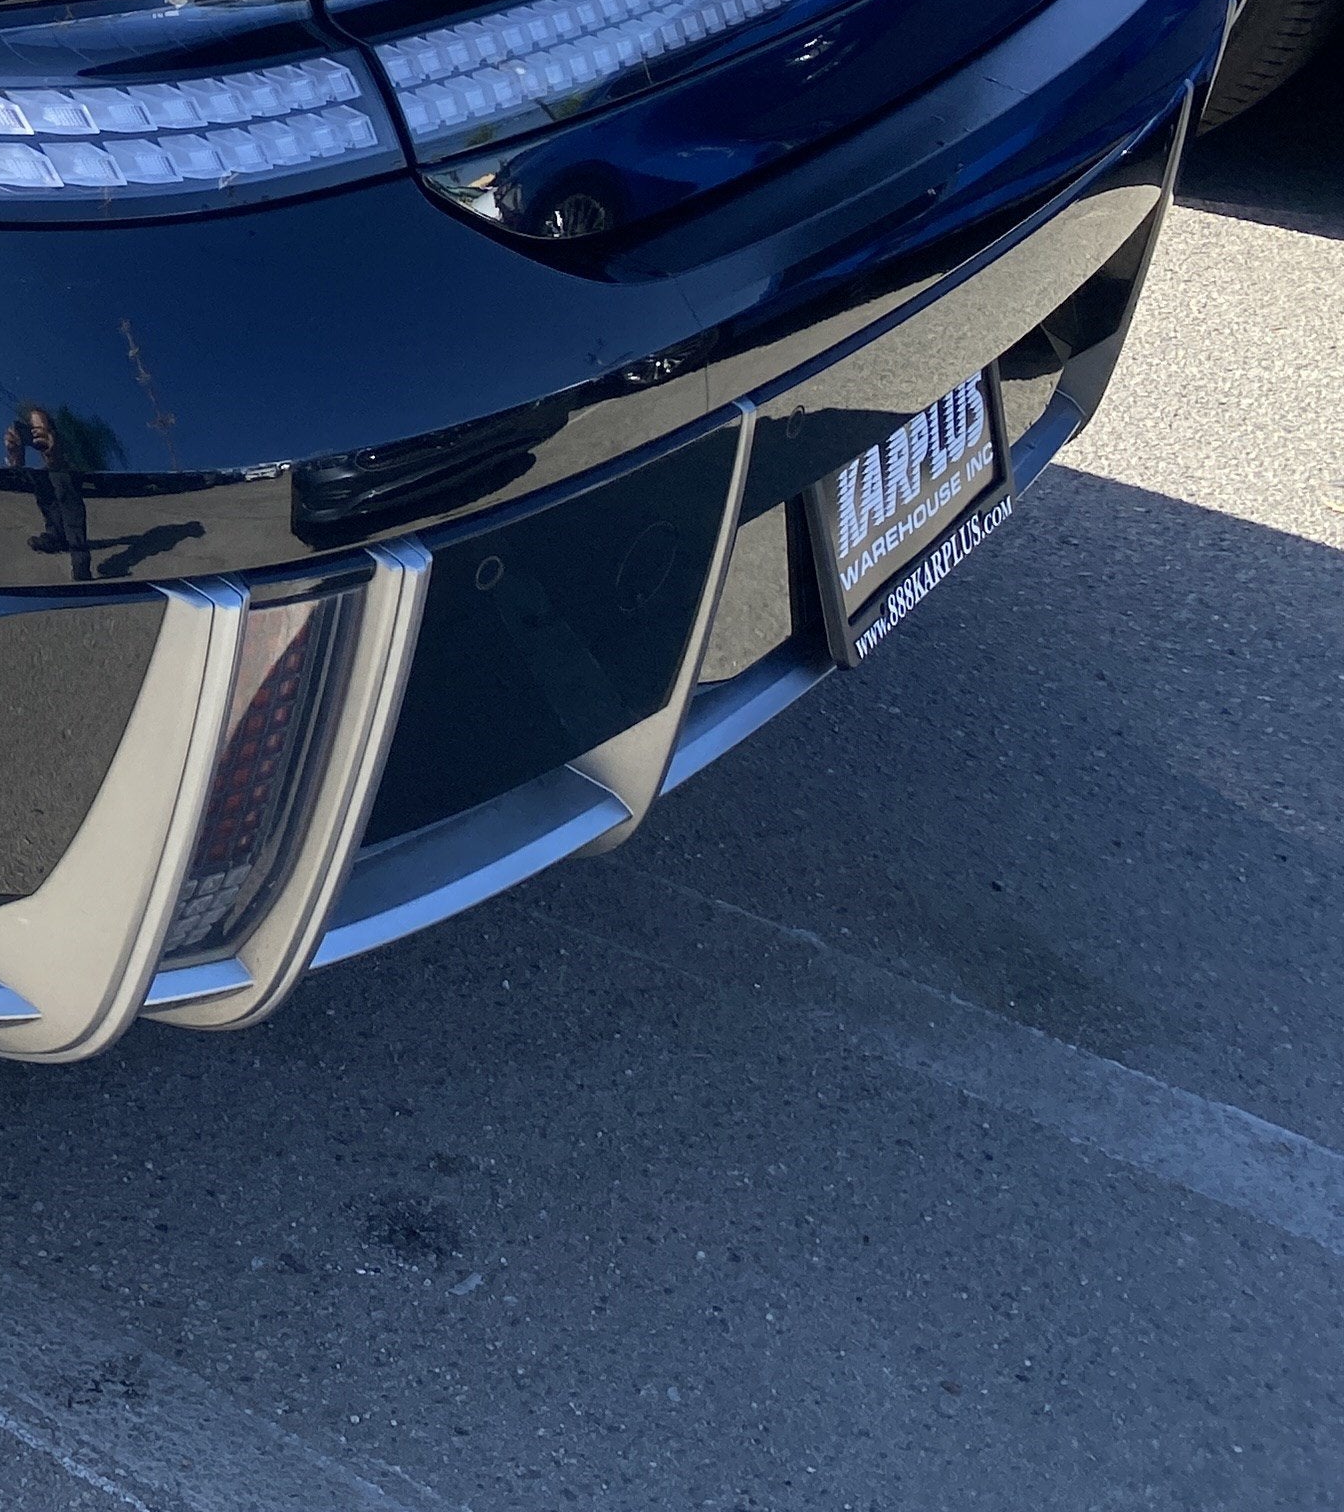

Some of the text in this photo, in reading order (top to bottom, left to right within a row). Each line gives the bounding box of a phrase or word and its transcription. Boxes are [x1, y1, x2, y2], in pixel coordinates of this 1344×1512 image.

[837, 370, 985, 559] KARPLUS
[840, 441, 994, 591] WAREHOUSE INC
